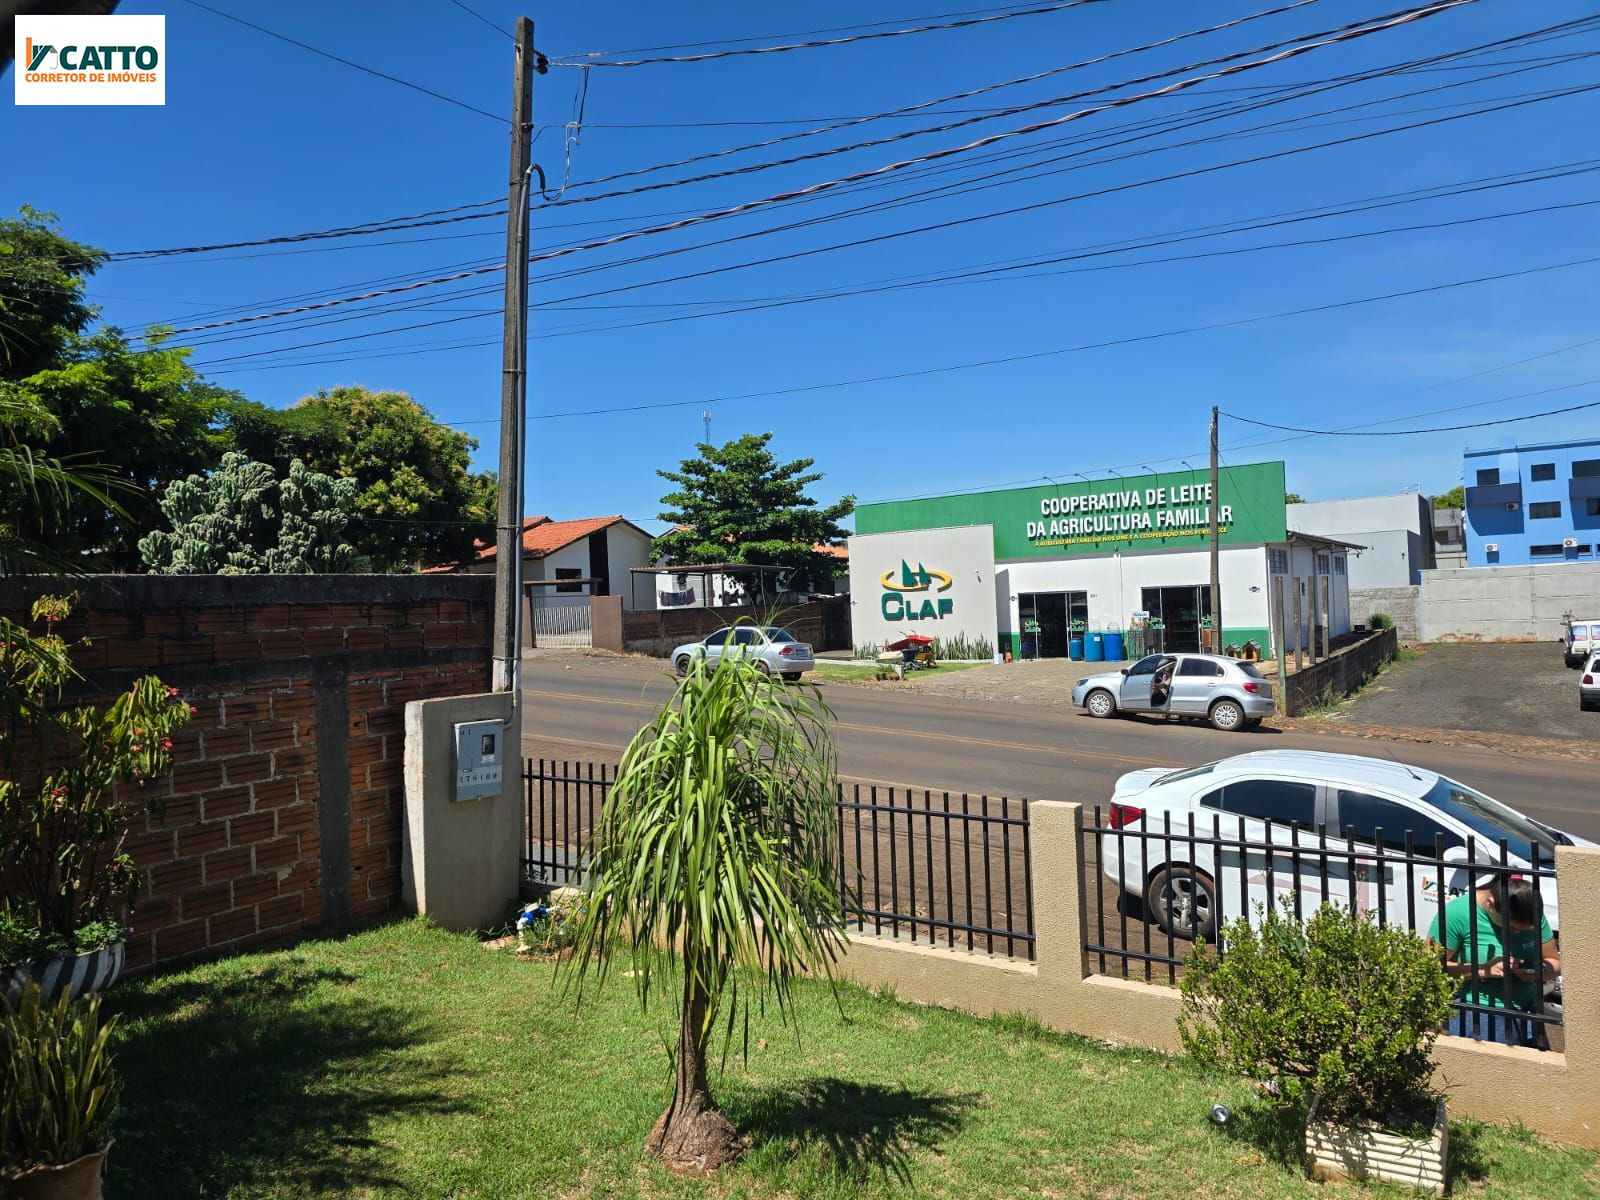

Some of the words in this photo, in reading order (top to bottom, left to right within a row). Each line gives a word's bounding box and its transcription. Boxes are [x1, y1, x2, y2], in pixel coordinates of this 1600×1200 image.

[1041, 490, 1141, 515] COOPERATIVA
[1145, 487, 1166, 506] DE
[1171, 483, 1212, 504] LEITE
[1027, 519, 1046, 538] DA
[1050, 511, 1151, 536] AGRICULTURA
